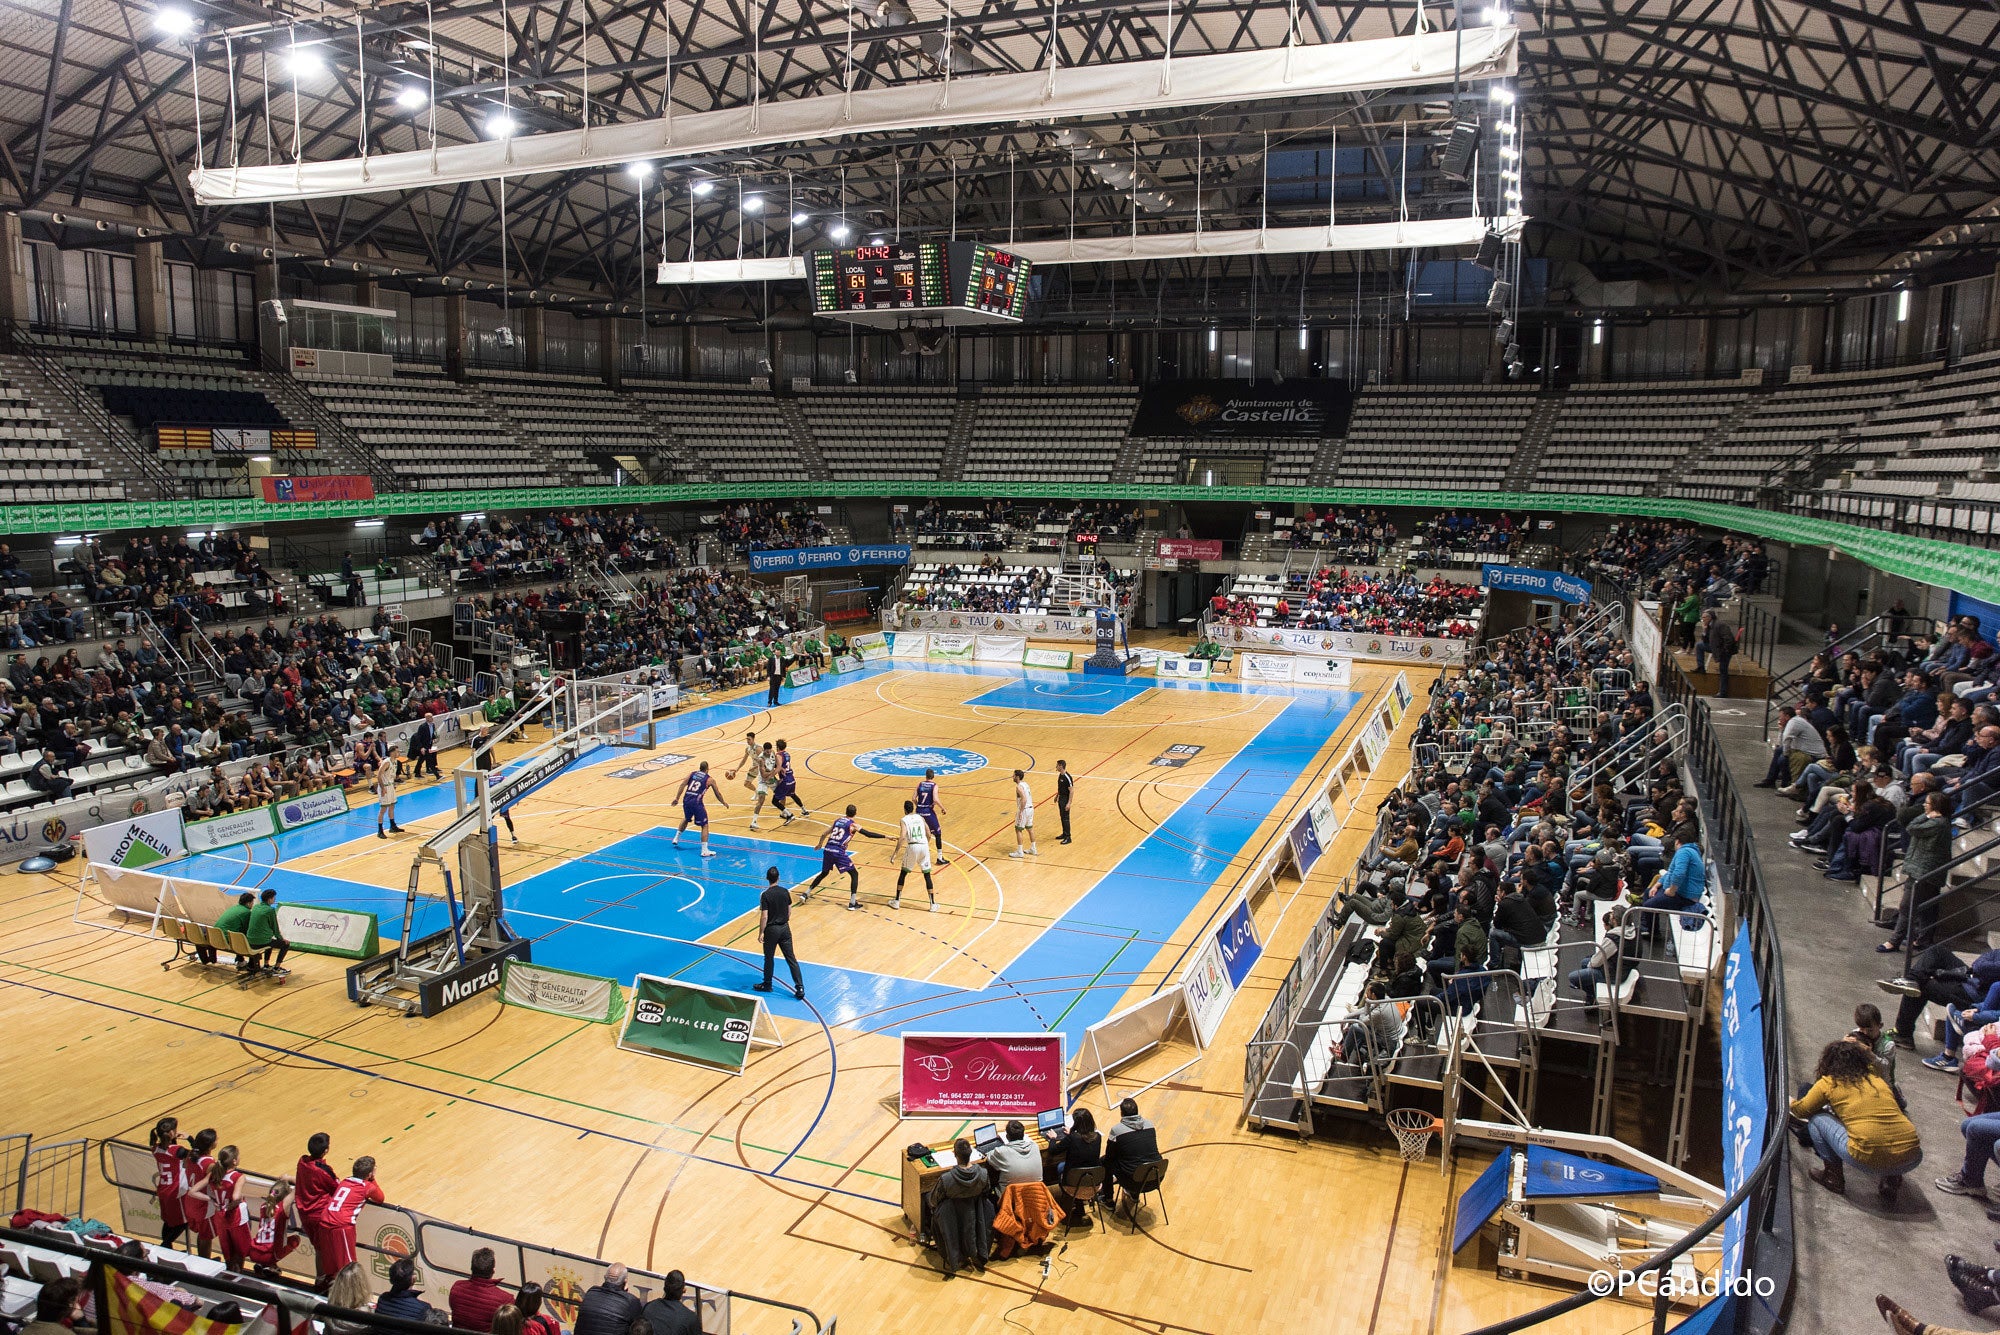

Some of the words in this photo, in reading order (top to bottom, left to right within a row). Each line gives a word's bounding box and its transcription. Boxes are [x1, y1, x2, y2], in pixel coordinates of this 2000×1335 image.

[857, 246, 890, 260] 04:42
[876, 268, 882, 276] 4
[851, 276, 865, 287] 64
[900, 272, 914, 285] 76
[858, 292, 864, 302] 3
[907, 290, 912, 300] 3
[1226, 399, 1295, 409] Ajuntament
[1221, 408, 1310, 422] Castelló
[1076, 534, 1098, 542] 04:42
[862, 550, 906, 559] FERRO
[1083, 546, 1094, 555] 15
[763, 556, 794, 566] FERRO
[808, 552, 841, 562] FERRO
[1504, 574, 1546, 588] FERRO
[967, 616, 989, 626] TAU
[1053, 620, 1076, 631] TAU
[1292, 633, 1316, 645] TAU
[1389, 641, 1414, 652] TAU
[1304, 671, 1342, 679] ecopostural
[544, 756, 564, 774] Marzá
[517, 774, 538, 791] Marzá
[688, 780, 701, 791] 13
[921, 793, 928, 803] 7
[0, 820, 29, 844] AU
[217, 820, 254, 833] GENERALITAT
[219, 826, 255, 839] VALENCIANA
[912, 826, 923, 838] 44
[830, 827, 845, 839] 23
[110, 832, 134, 866] EROY
[129, 824, 172, 857] MERLIN
[293, 918, 339, 930] Mondent
[442, 963, 499, 1006] Marzá
[541, 983, 587, 996] GENERALITAT
[1189, 967, 1209, 1014] TAU
[541, 990, 585, 1005] VALENCIANA
[641, 1004, 662, 1012] ONDA
[640, 1013, 659, 1022] CERO
[666, 1016, 690, 1026] ONDA
[693, 1020, 720, 1031] CERO
[727, 1022, 747, 1030] ONDA
[964, 1057, 1048, 1082] Planabus
[328, 1187, 350, 1212] 9
